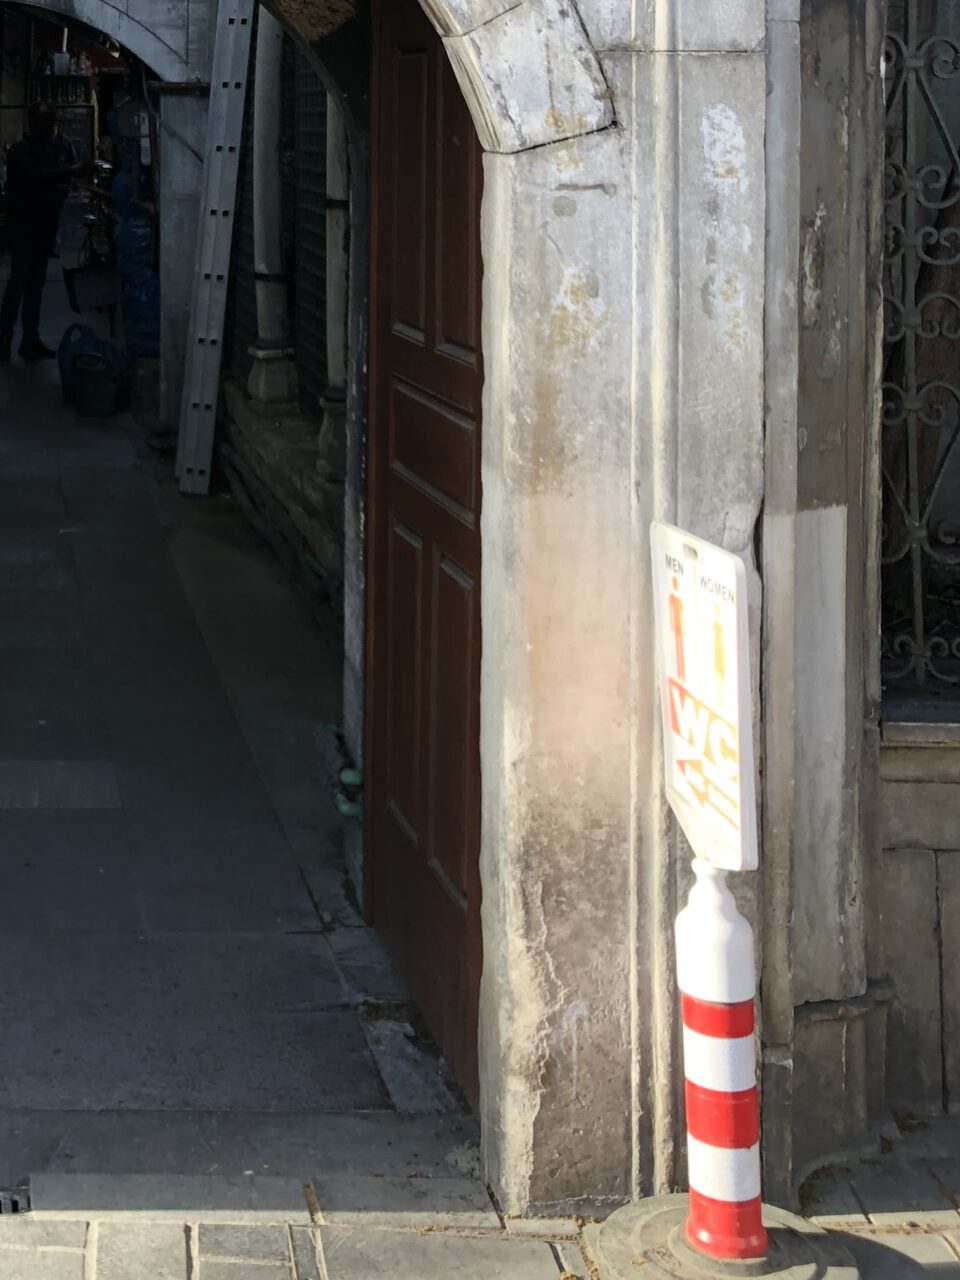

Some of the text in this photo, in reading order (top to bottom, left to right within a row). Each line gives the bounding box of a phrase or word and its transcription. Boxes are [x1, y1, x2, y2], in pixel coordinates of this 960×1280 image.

[665, 554, 685, 576] MEN
[700, 575, 735, 604] WOMEN
[671, 686, 738, 777] WC
